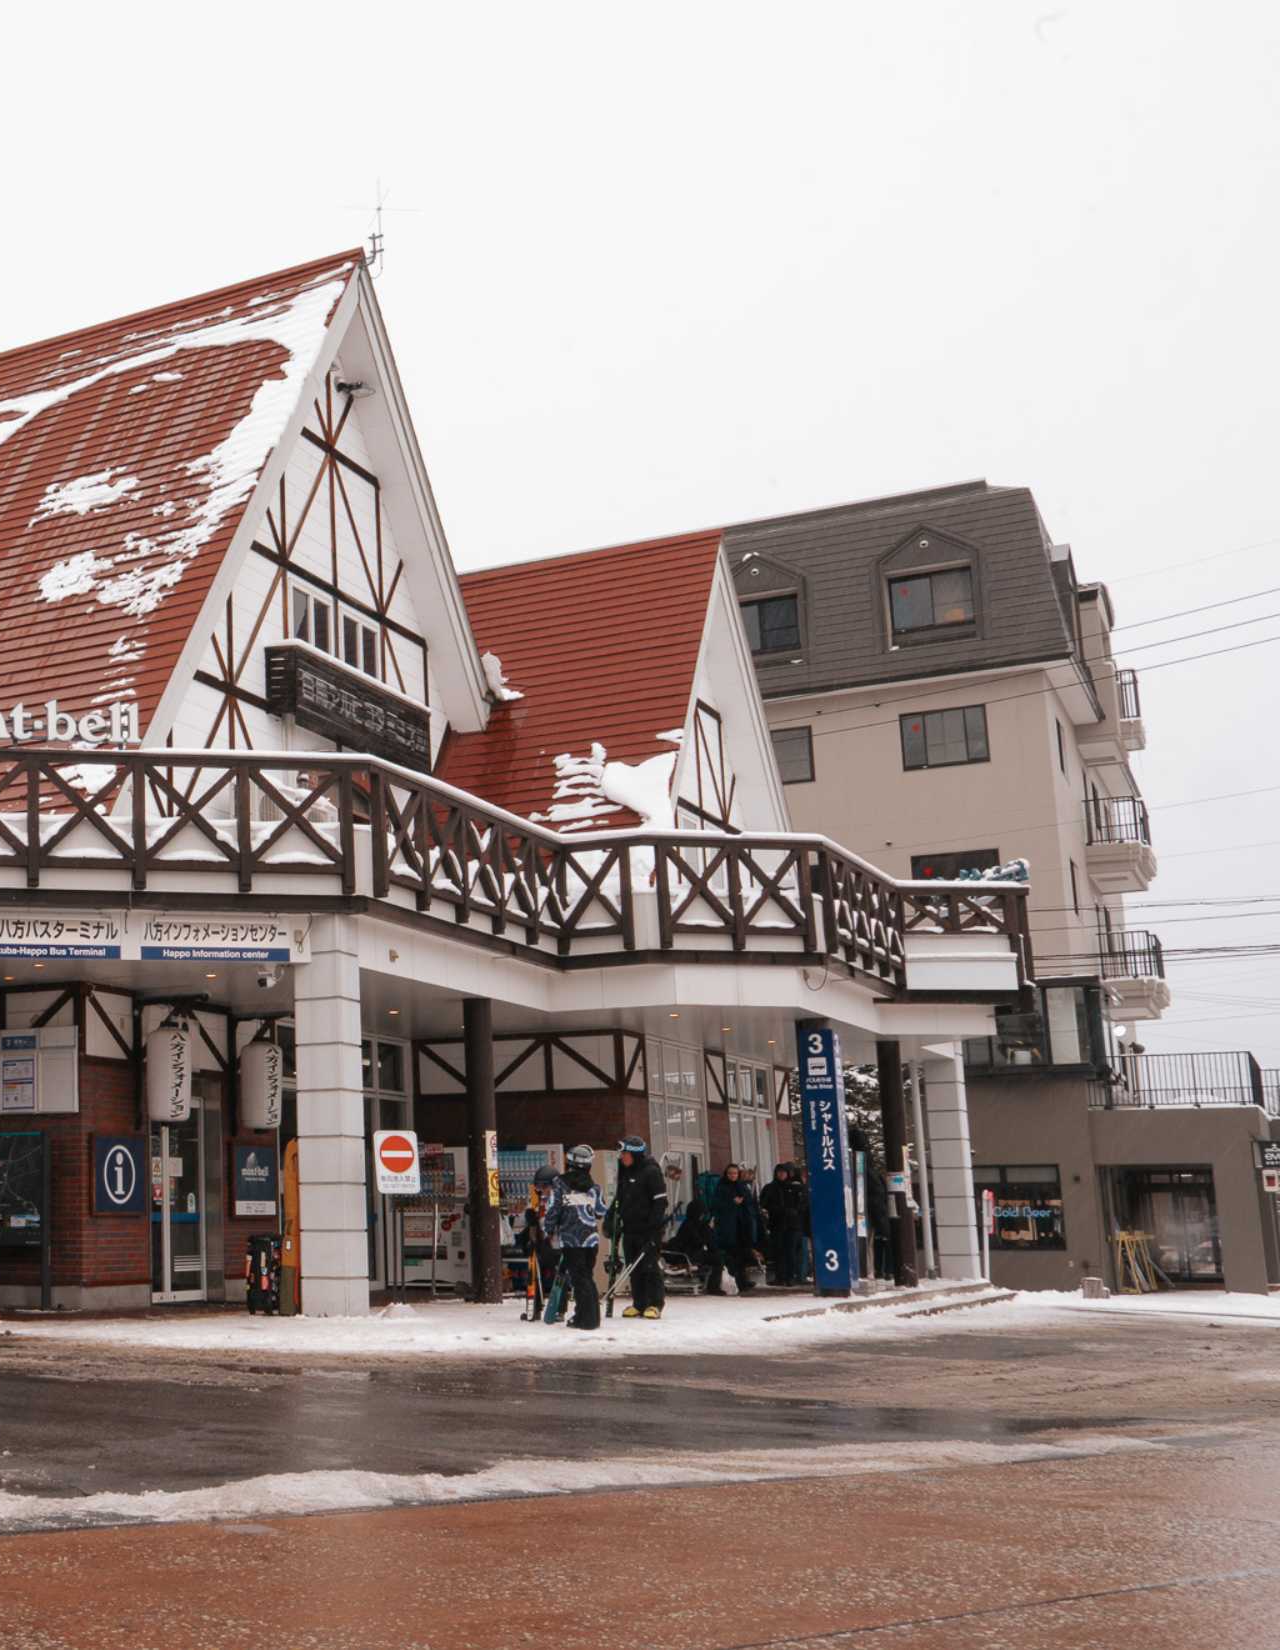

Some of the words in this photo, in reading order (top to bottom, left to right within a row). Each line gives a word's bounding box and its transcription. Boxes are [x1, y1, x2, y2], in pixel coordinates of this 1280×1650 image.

[144, 922, 287, 942] 八方インフォメーションセンター
[50, 946, 66, 956] Bus
[69, 947, 106, 956] Terminal
[162, 949, 191, 960] Happo
[192, 949, 241, 958] Information
[242, 950, 270, 958] center
[808, 1033, 824, 1054] 3
[170, 1032, 186, 1118] 八方インフォメーション
[819, 1100, 835, 1170] シャトルバス
[993, 1206, 1019, 1217] Cold
[1023, 1206, 1052, 1217] Beer
[825, 1250, 840, 1271] 3
